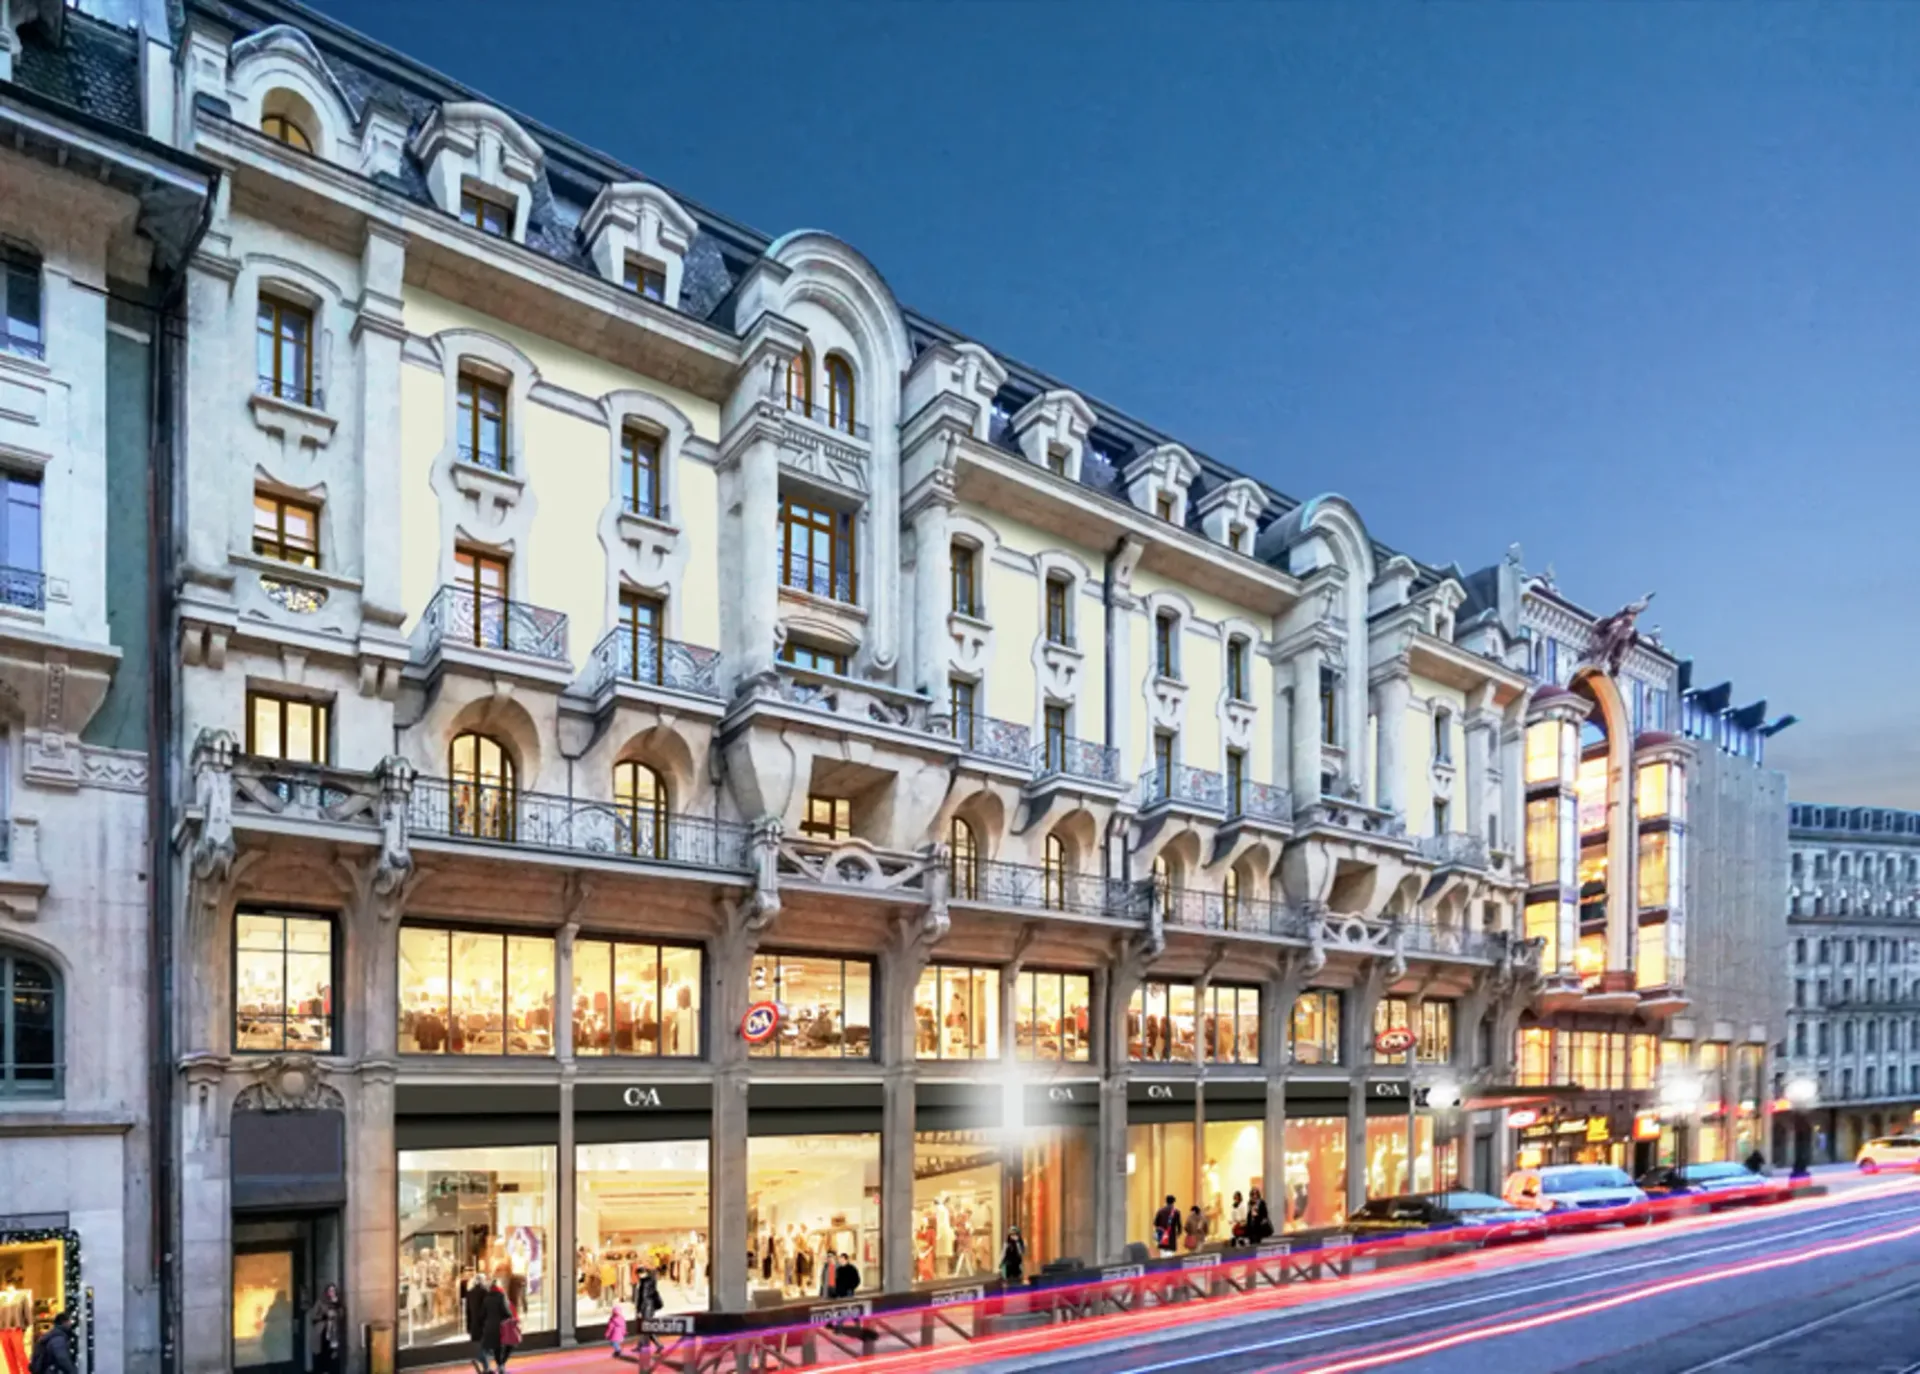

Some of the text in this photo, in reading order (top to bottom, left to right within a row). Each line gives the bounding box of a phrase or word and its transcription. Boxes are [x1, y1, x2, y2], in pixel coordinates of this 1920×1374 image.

[1148, 1085, 1173, 1098] C&A
[1376, 1083, 1400, 1096] C&A
[623, 1087, 661, 1106] C&A
